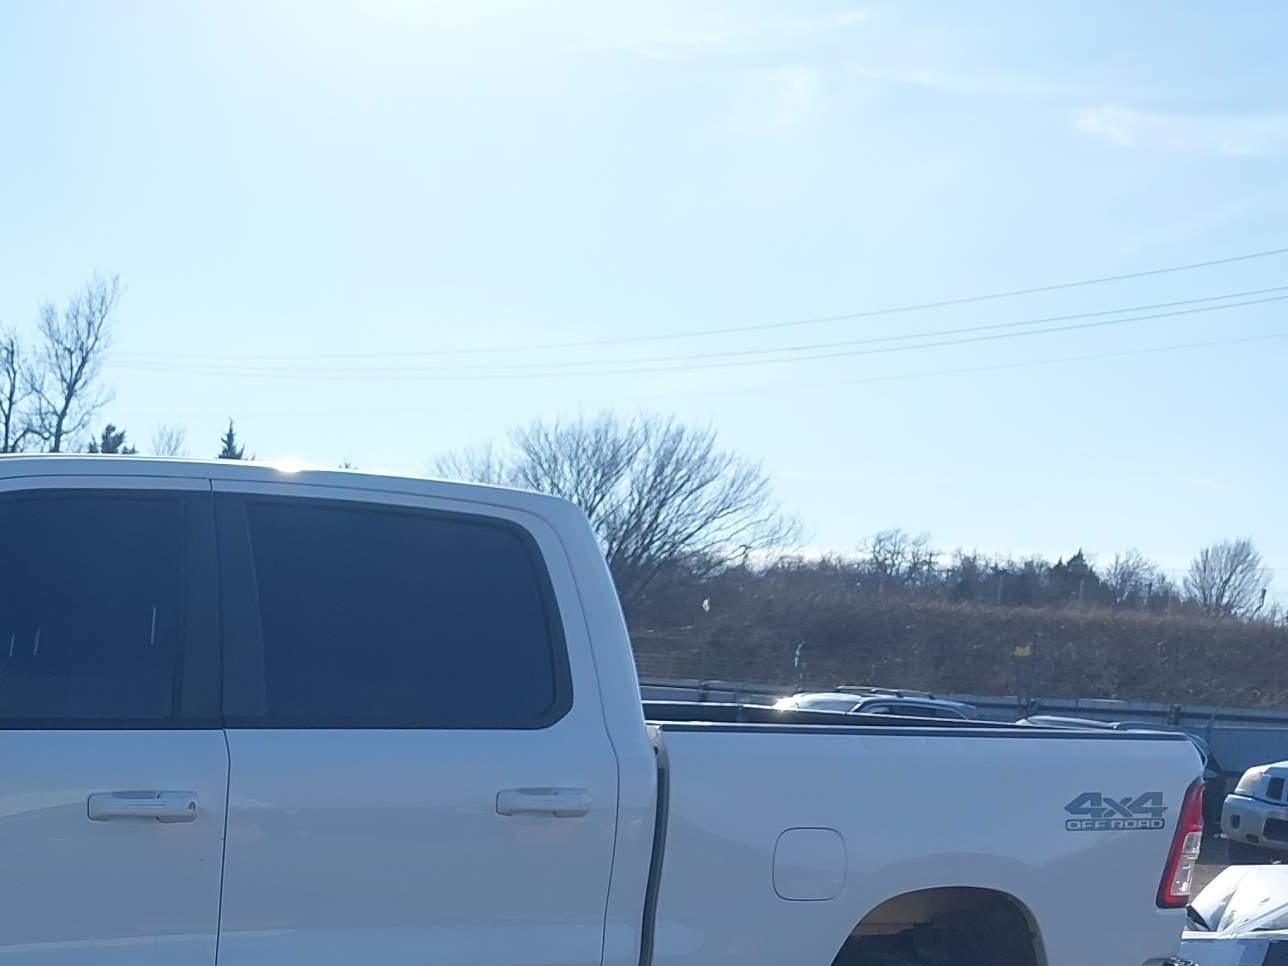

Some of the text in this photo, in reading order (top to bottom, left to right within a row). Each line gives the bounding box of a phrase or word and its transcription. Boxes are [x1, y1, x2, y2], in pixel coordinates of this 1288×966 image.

[1064, 791, 1169, 819] 4x4
[1067, 819, 1164, 830] OFF ROAD
